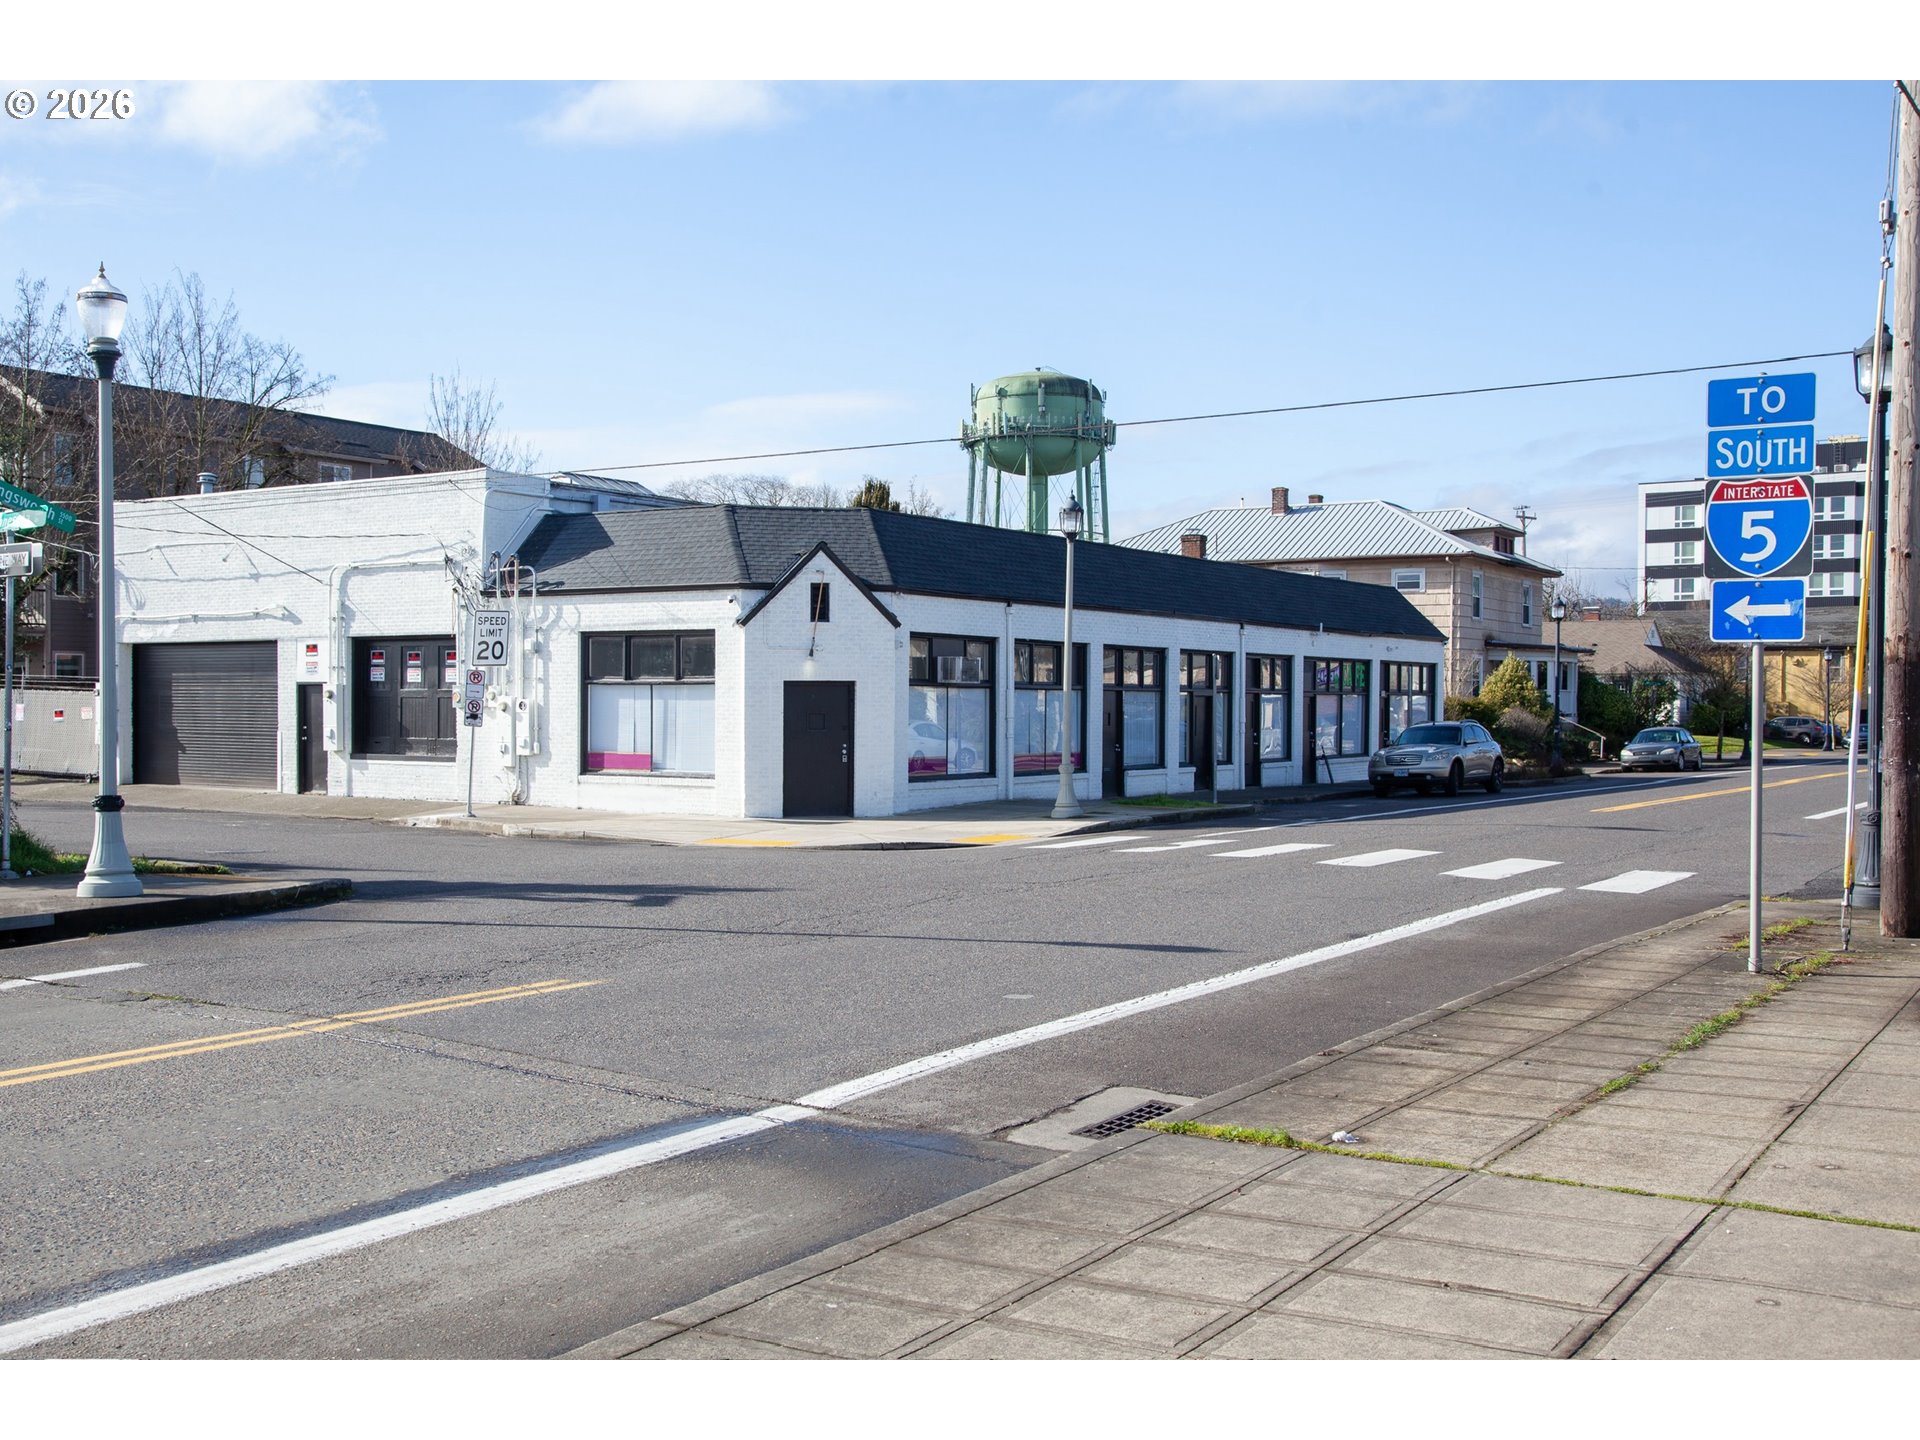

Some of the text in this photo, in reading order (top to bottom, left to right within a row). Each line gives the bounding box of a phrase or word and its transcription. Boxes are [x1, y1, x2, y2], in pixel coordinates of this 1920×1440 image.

[1736, 386, 1786, 415] TO
[1715, 437, 1807, 470] SOUTH
[1723, 485, 1795, 499] INTERSTATE
[1739, 510, 1777, 563] 5
[11, 553, 27, 566] WAY
[478, 617, 506, 626] SPEED
[480, 628, 503, 637] LIMIT
[477, 640, 504, 660] 20
